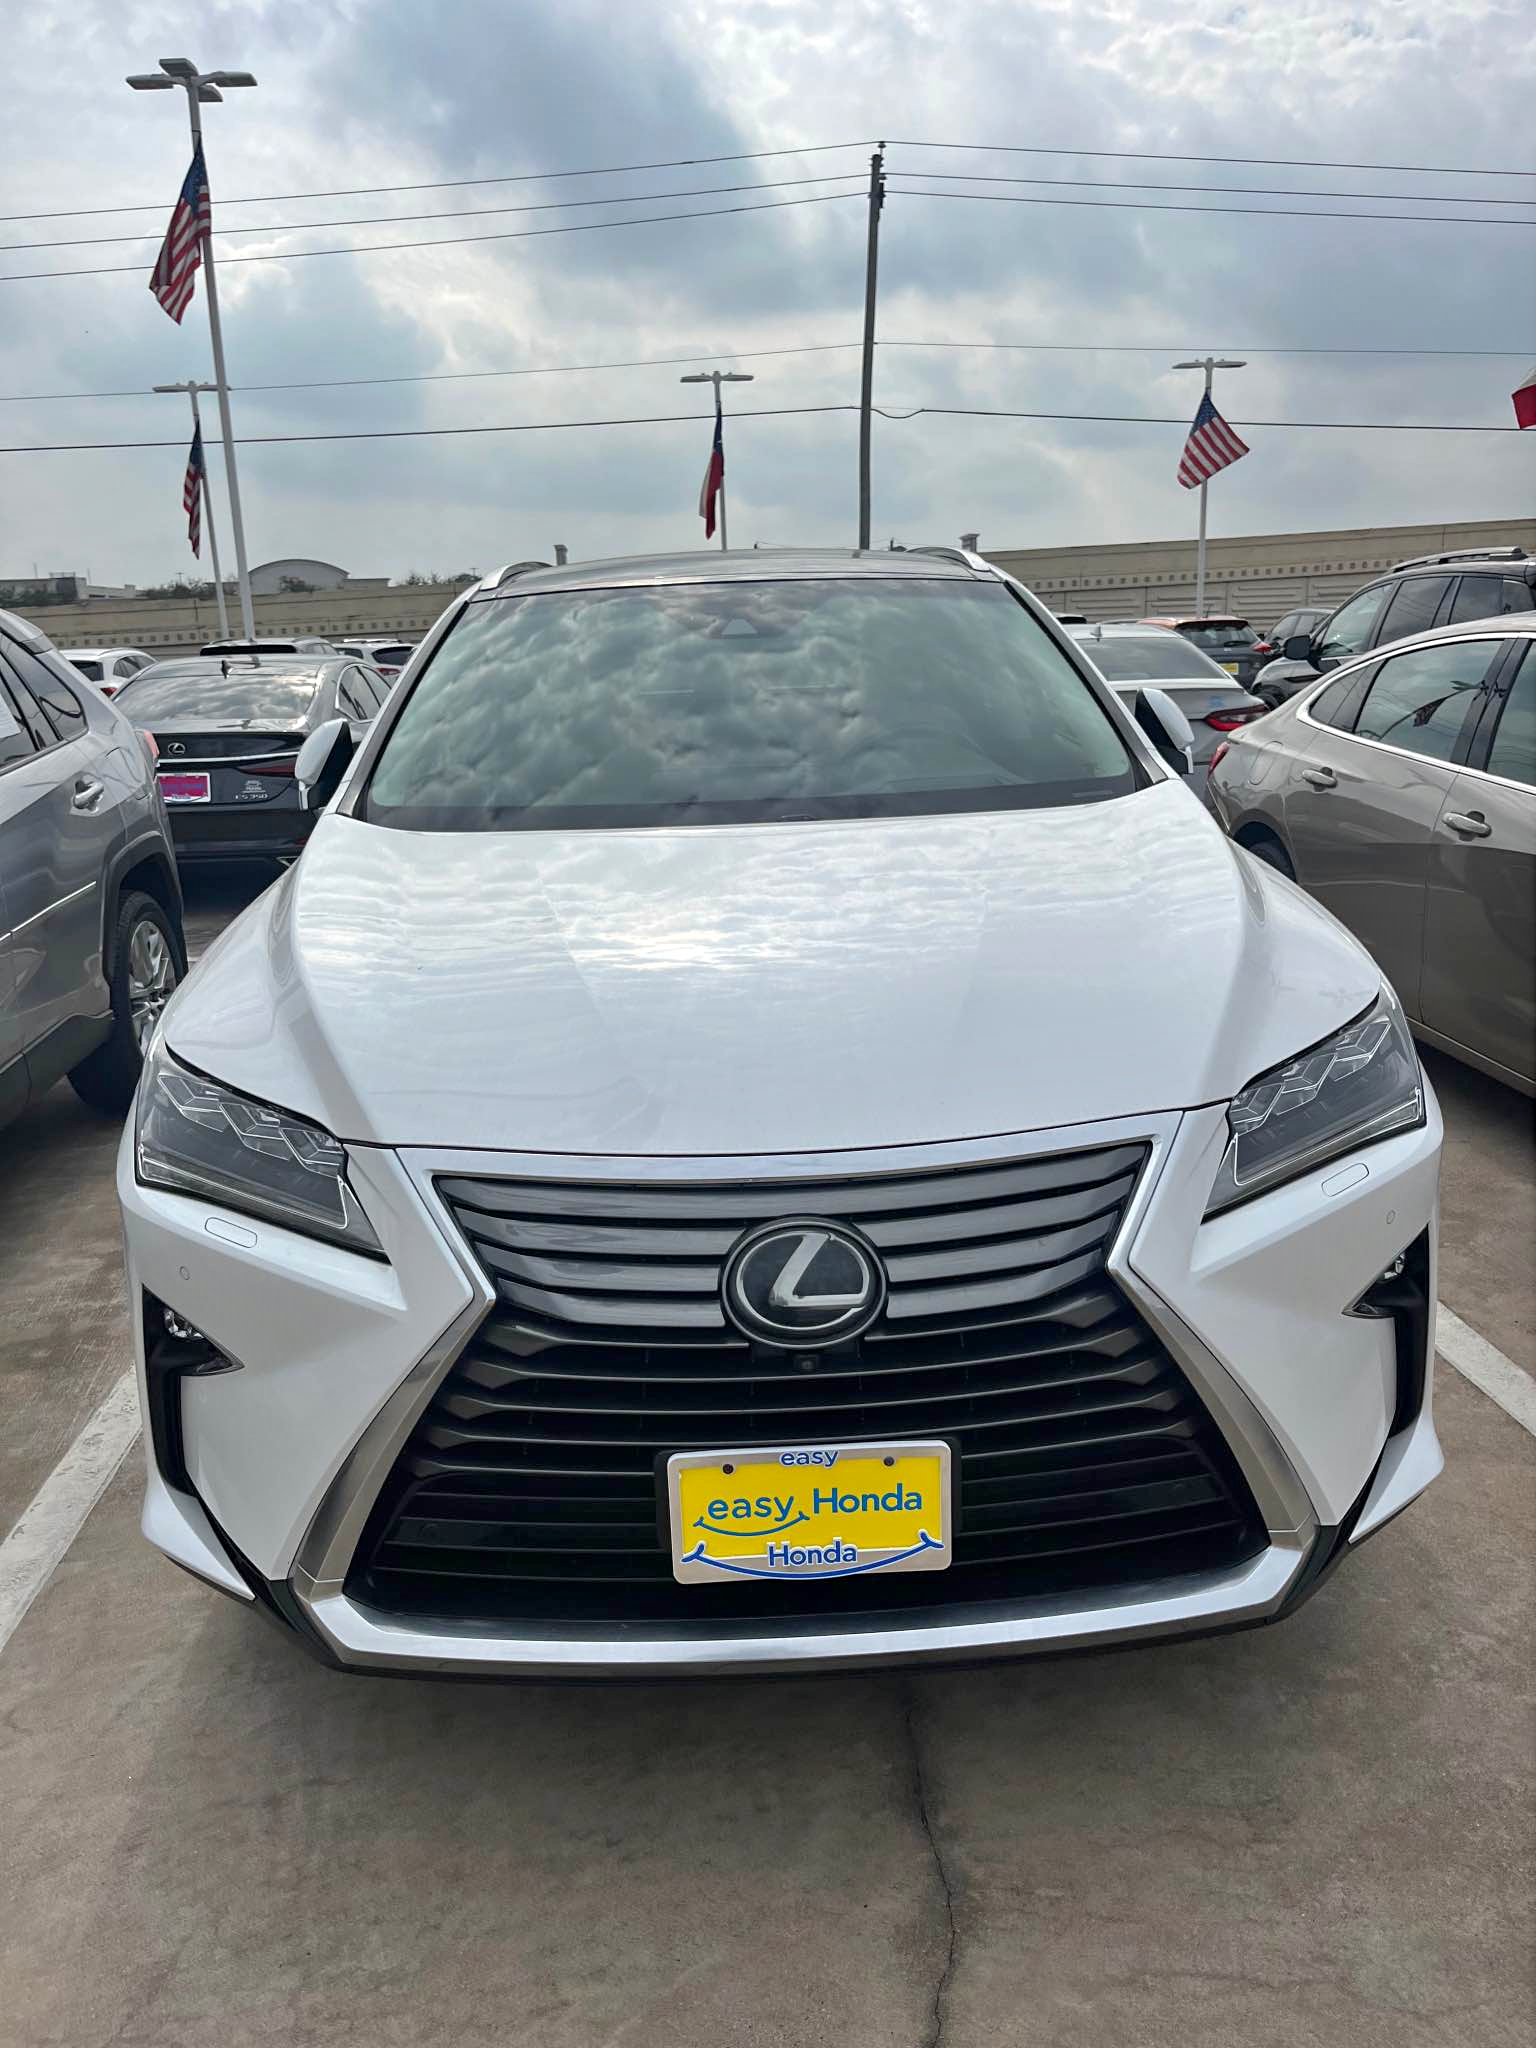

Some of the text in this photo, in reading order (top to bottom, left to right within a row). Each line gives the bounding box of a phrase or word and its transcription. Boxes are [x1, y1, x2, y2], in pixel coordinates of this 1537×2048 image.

[780, 1451, 838, 1467] easy
[708, 1483, 923, 1522] easy Honda
[767, 1539, 857, 1567] Honda
